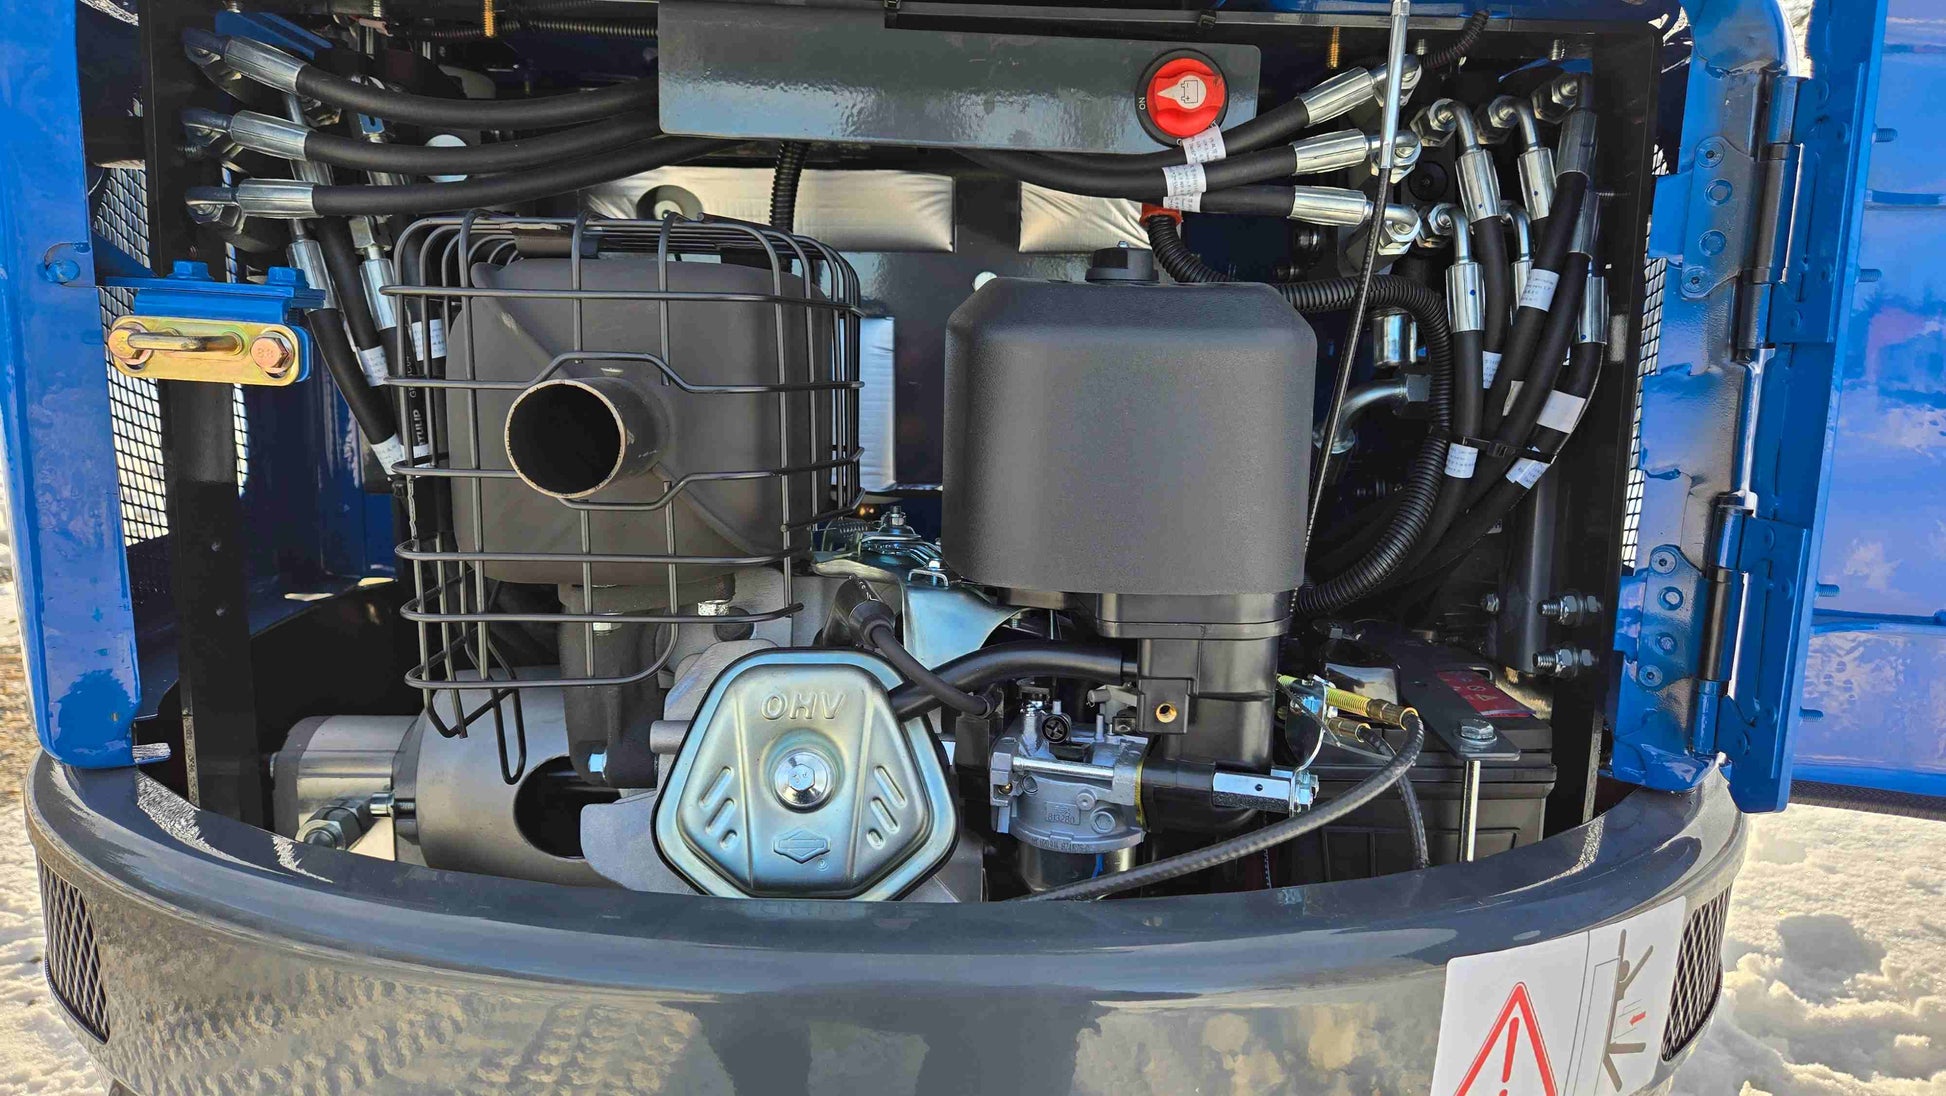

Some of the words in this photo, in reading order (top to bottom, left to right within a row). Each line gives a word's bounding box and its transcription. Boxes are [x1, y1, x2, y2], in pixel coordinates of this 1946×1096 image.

[1138, 97, 1146, 110] ON
[412, 408, 424, 445] TULIP
[760, 692, 846, 721] OHV
